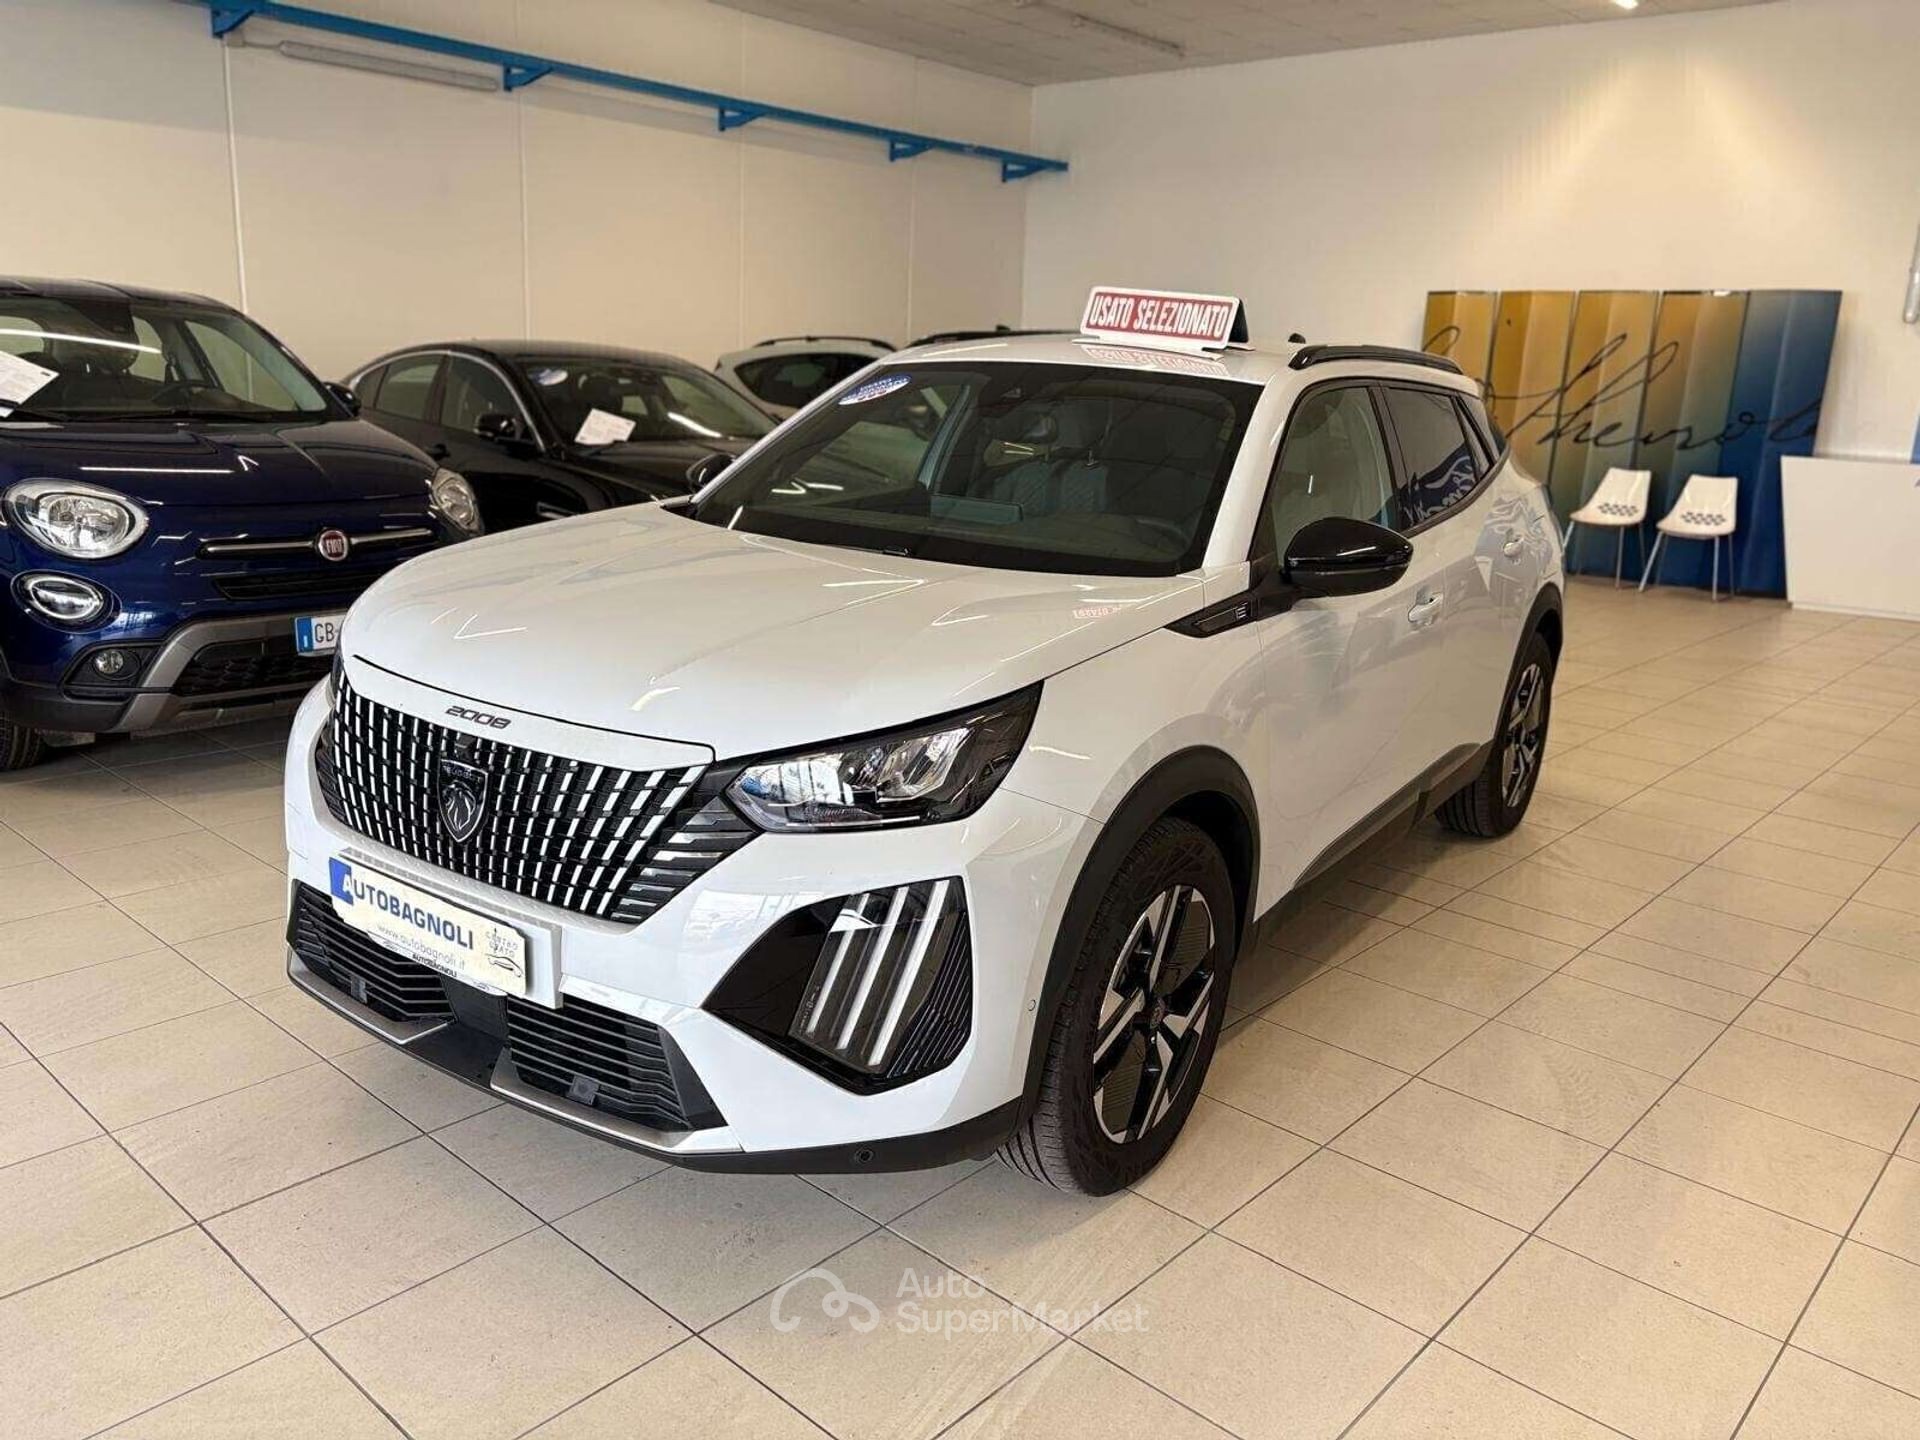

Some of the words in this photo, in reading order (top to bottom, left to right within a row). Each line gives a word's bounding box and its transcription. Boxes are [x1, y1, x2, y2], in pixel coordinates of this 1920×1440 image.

[1089, 295, 1134, 329] USATO
[1133, 299, 1230, 338] SELEZIONATO
[445, 705, 512, 729] 2008
[341, 872, 474, 950] AUTOBAGNOLI
